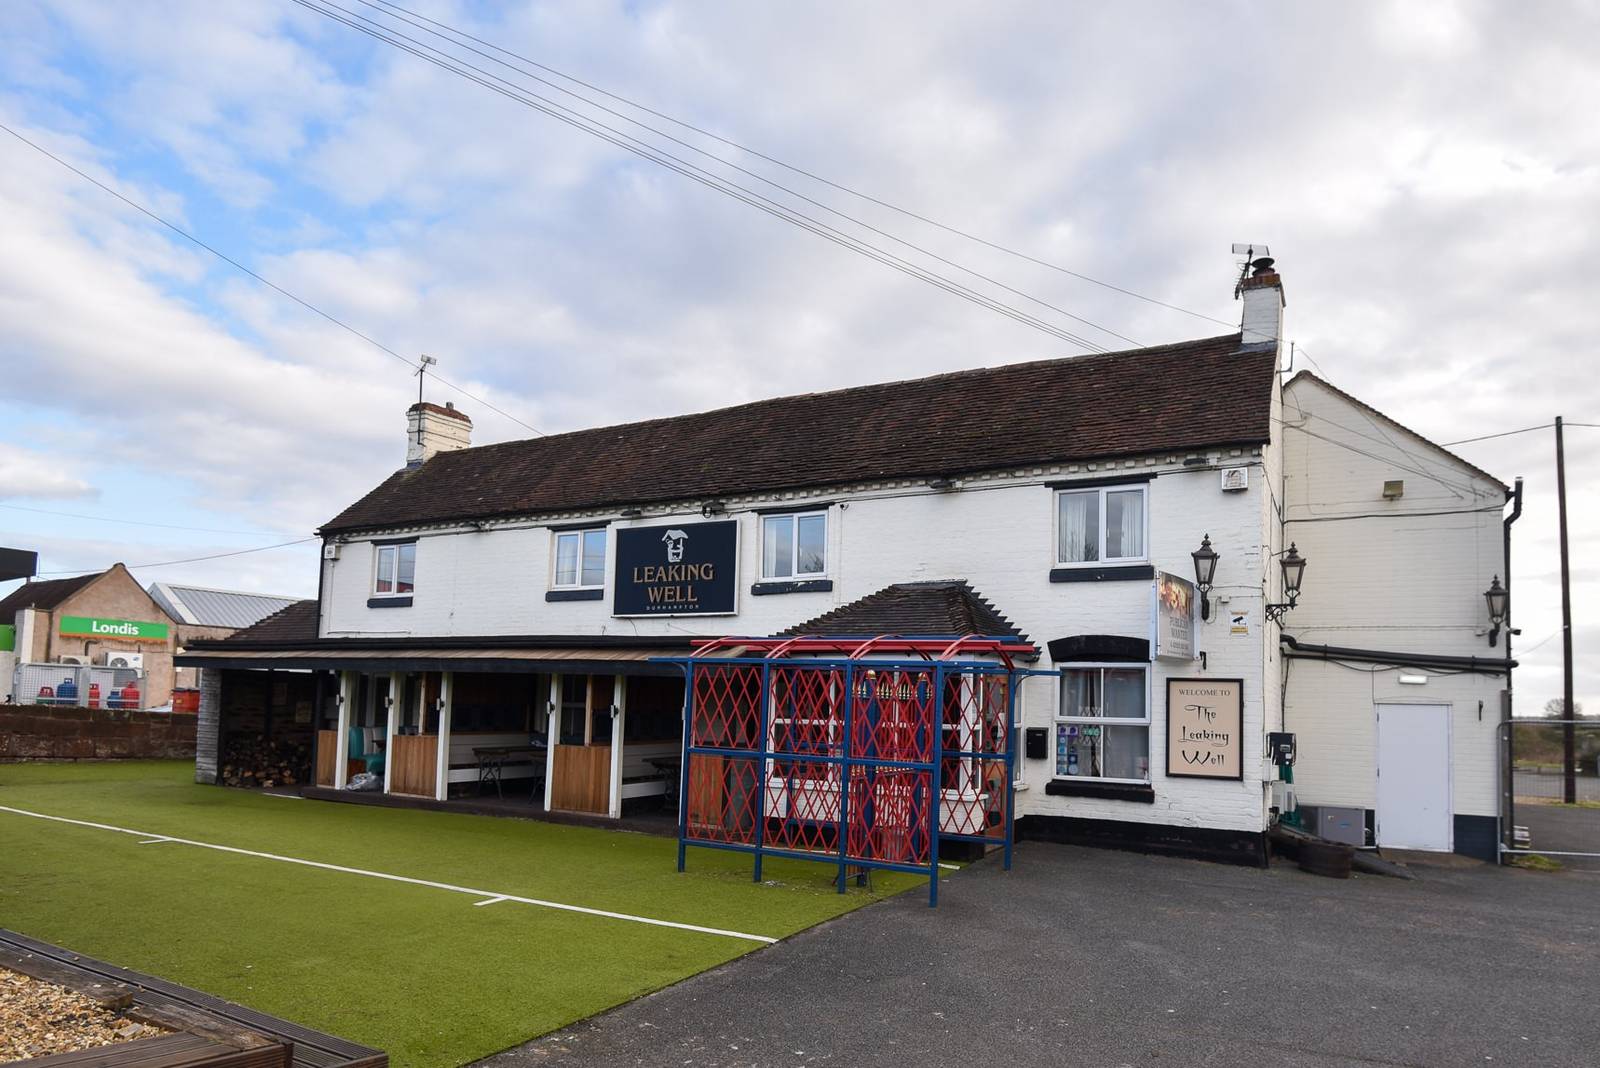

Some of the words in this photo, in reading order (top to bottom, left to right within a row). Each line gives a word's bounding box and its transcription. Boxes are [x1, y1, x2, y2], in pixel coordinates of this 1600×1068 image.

[633, 563, 714, 583] LEAKING
[647, 585, 698, 603] WELL
[91, 621, 140, 636] Londis
[1179, 688, 1217, 697] WELCOME
[1220, 689, 1231, 697] TO
[1184, 704, 1217, 725] The
[1178, 725, 1230, 748] Leaking
[1181, 750, 1225, 766] Well
